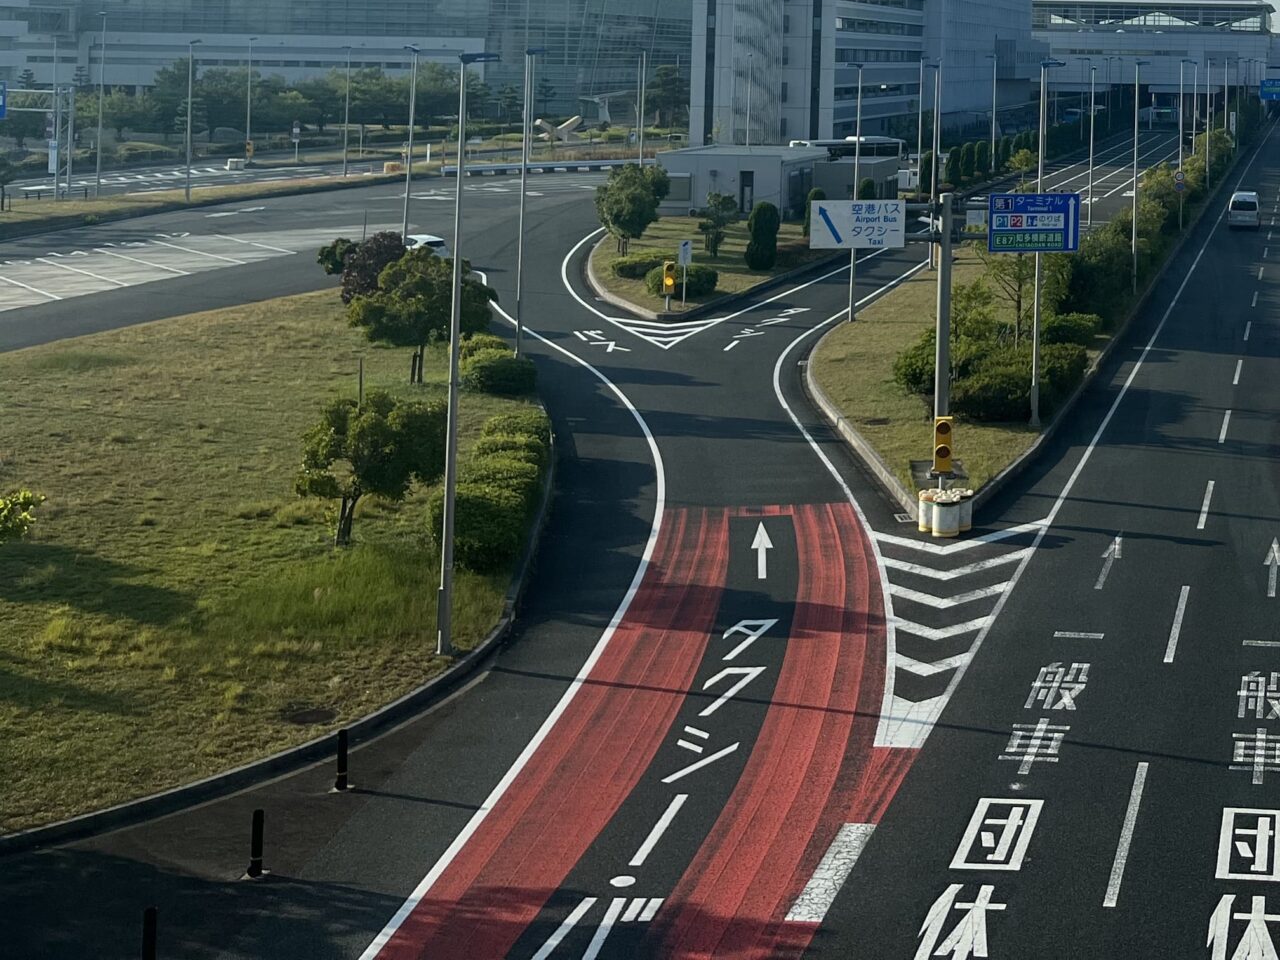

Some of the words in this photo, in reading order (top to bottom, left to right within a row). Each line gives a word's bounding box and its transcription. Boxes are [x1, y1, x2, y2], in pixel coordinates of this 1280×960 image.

[1016, 196, 1063, 205] ターミナル
[852, 204, 900, 214] 空港バス
[996, 217, 1008, 226] P1
[1010, 216, 1023, 226] P2
[852, 226, 900, 237] タクシー
[996, 237, 1013, 245] E87
